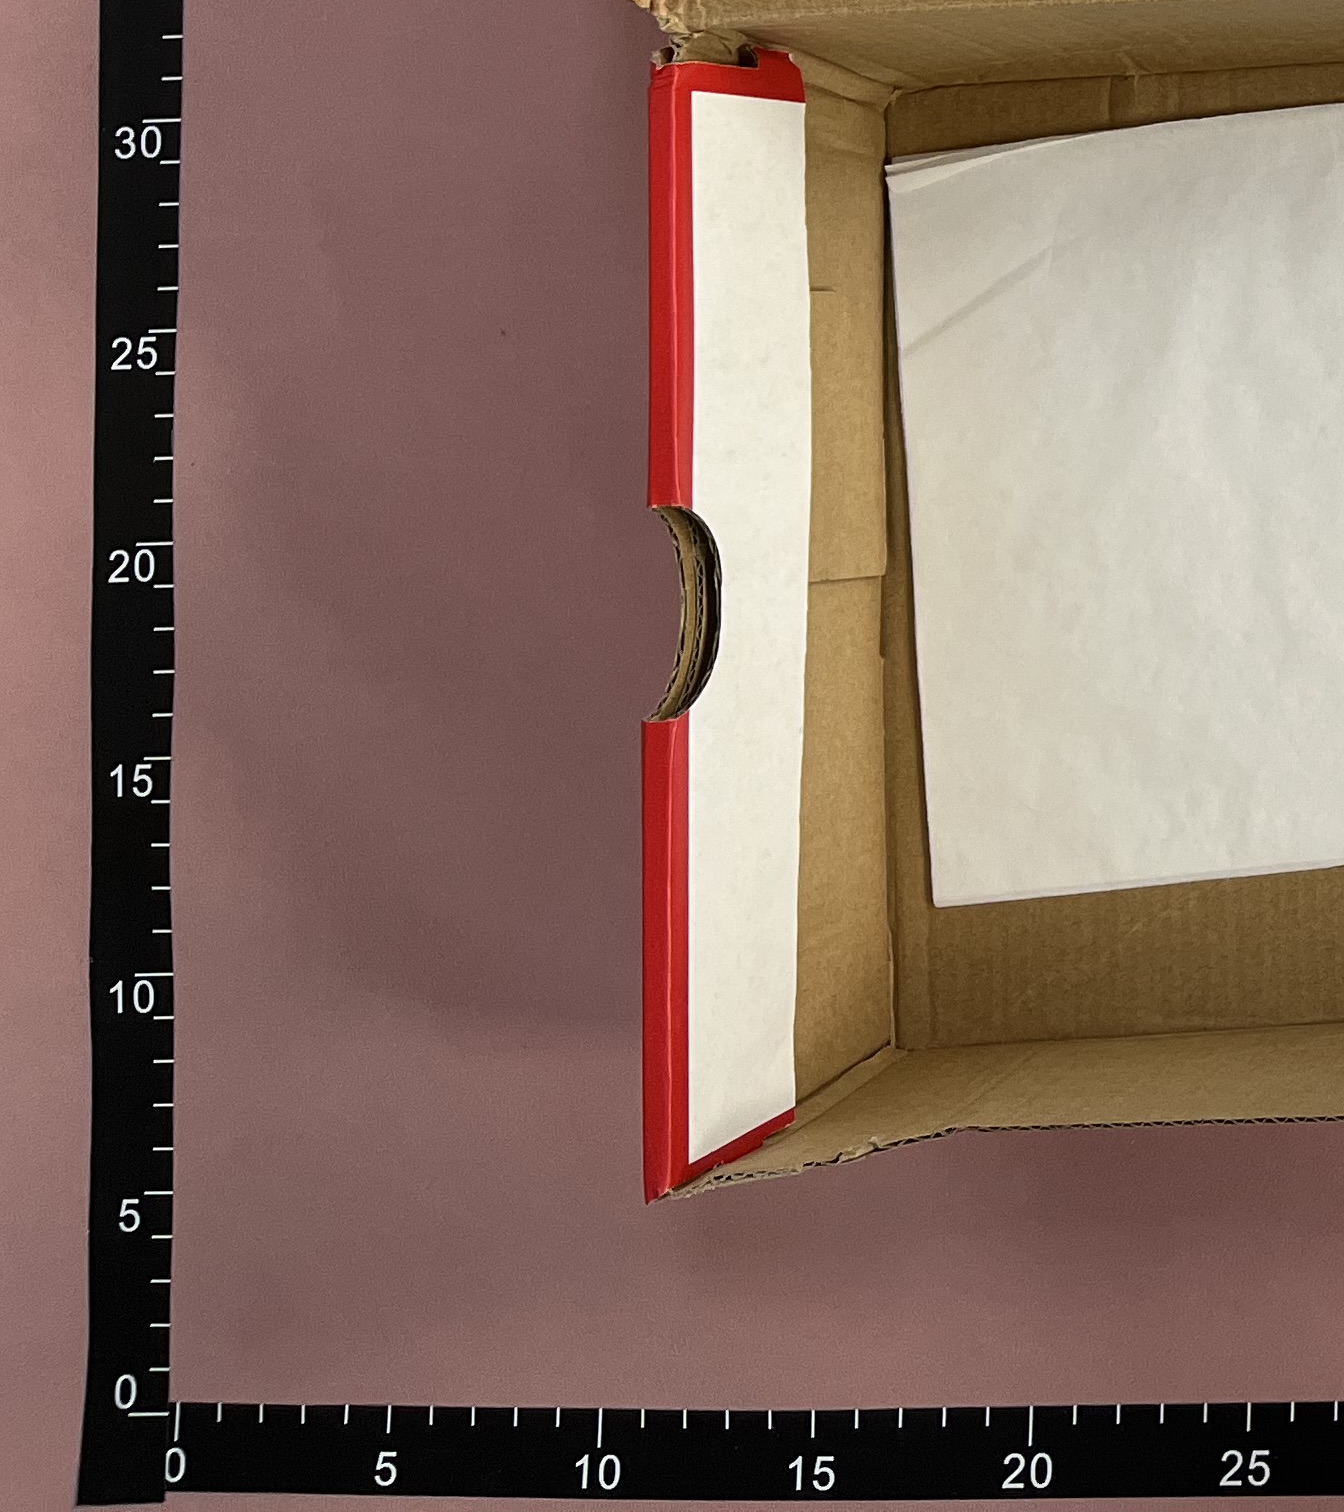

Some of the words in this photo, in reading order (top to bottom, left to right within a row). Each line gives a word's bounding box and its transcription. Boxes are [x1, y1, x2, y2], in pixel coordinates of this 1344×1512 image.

[114, 125, 162, 160] 30
[110, 336, 158, 371] 25
[107, 548, 155, 584] 20
[110, 763, 153, 798] 15
[109, 979, 155, 1014] 10
[118, 1198, 141, 1233] 5
[114, 1374, 137, 1410] 0
[165, 1447, 186, 1483] 0
[374, 1451, 397, 1487] 5
[575, 1454, 621, 1490] 10
[788, 1455, 835, 1491] 15
[1001, 1452, 1053, 1489] 20
[1219, 1449, 1271, 1486] 25
